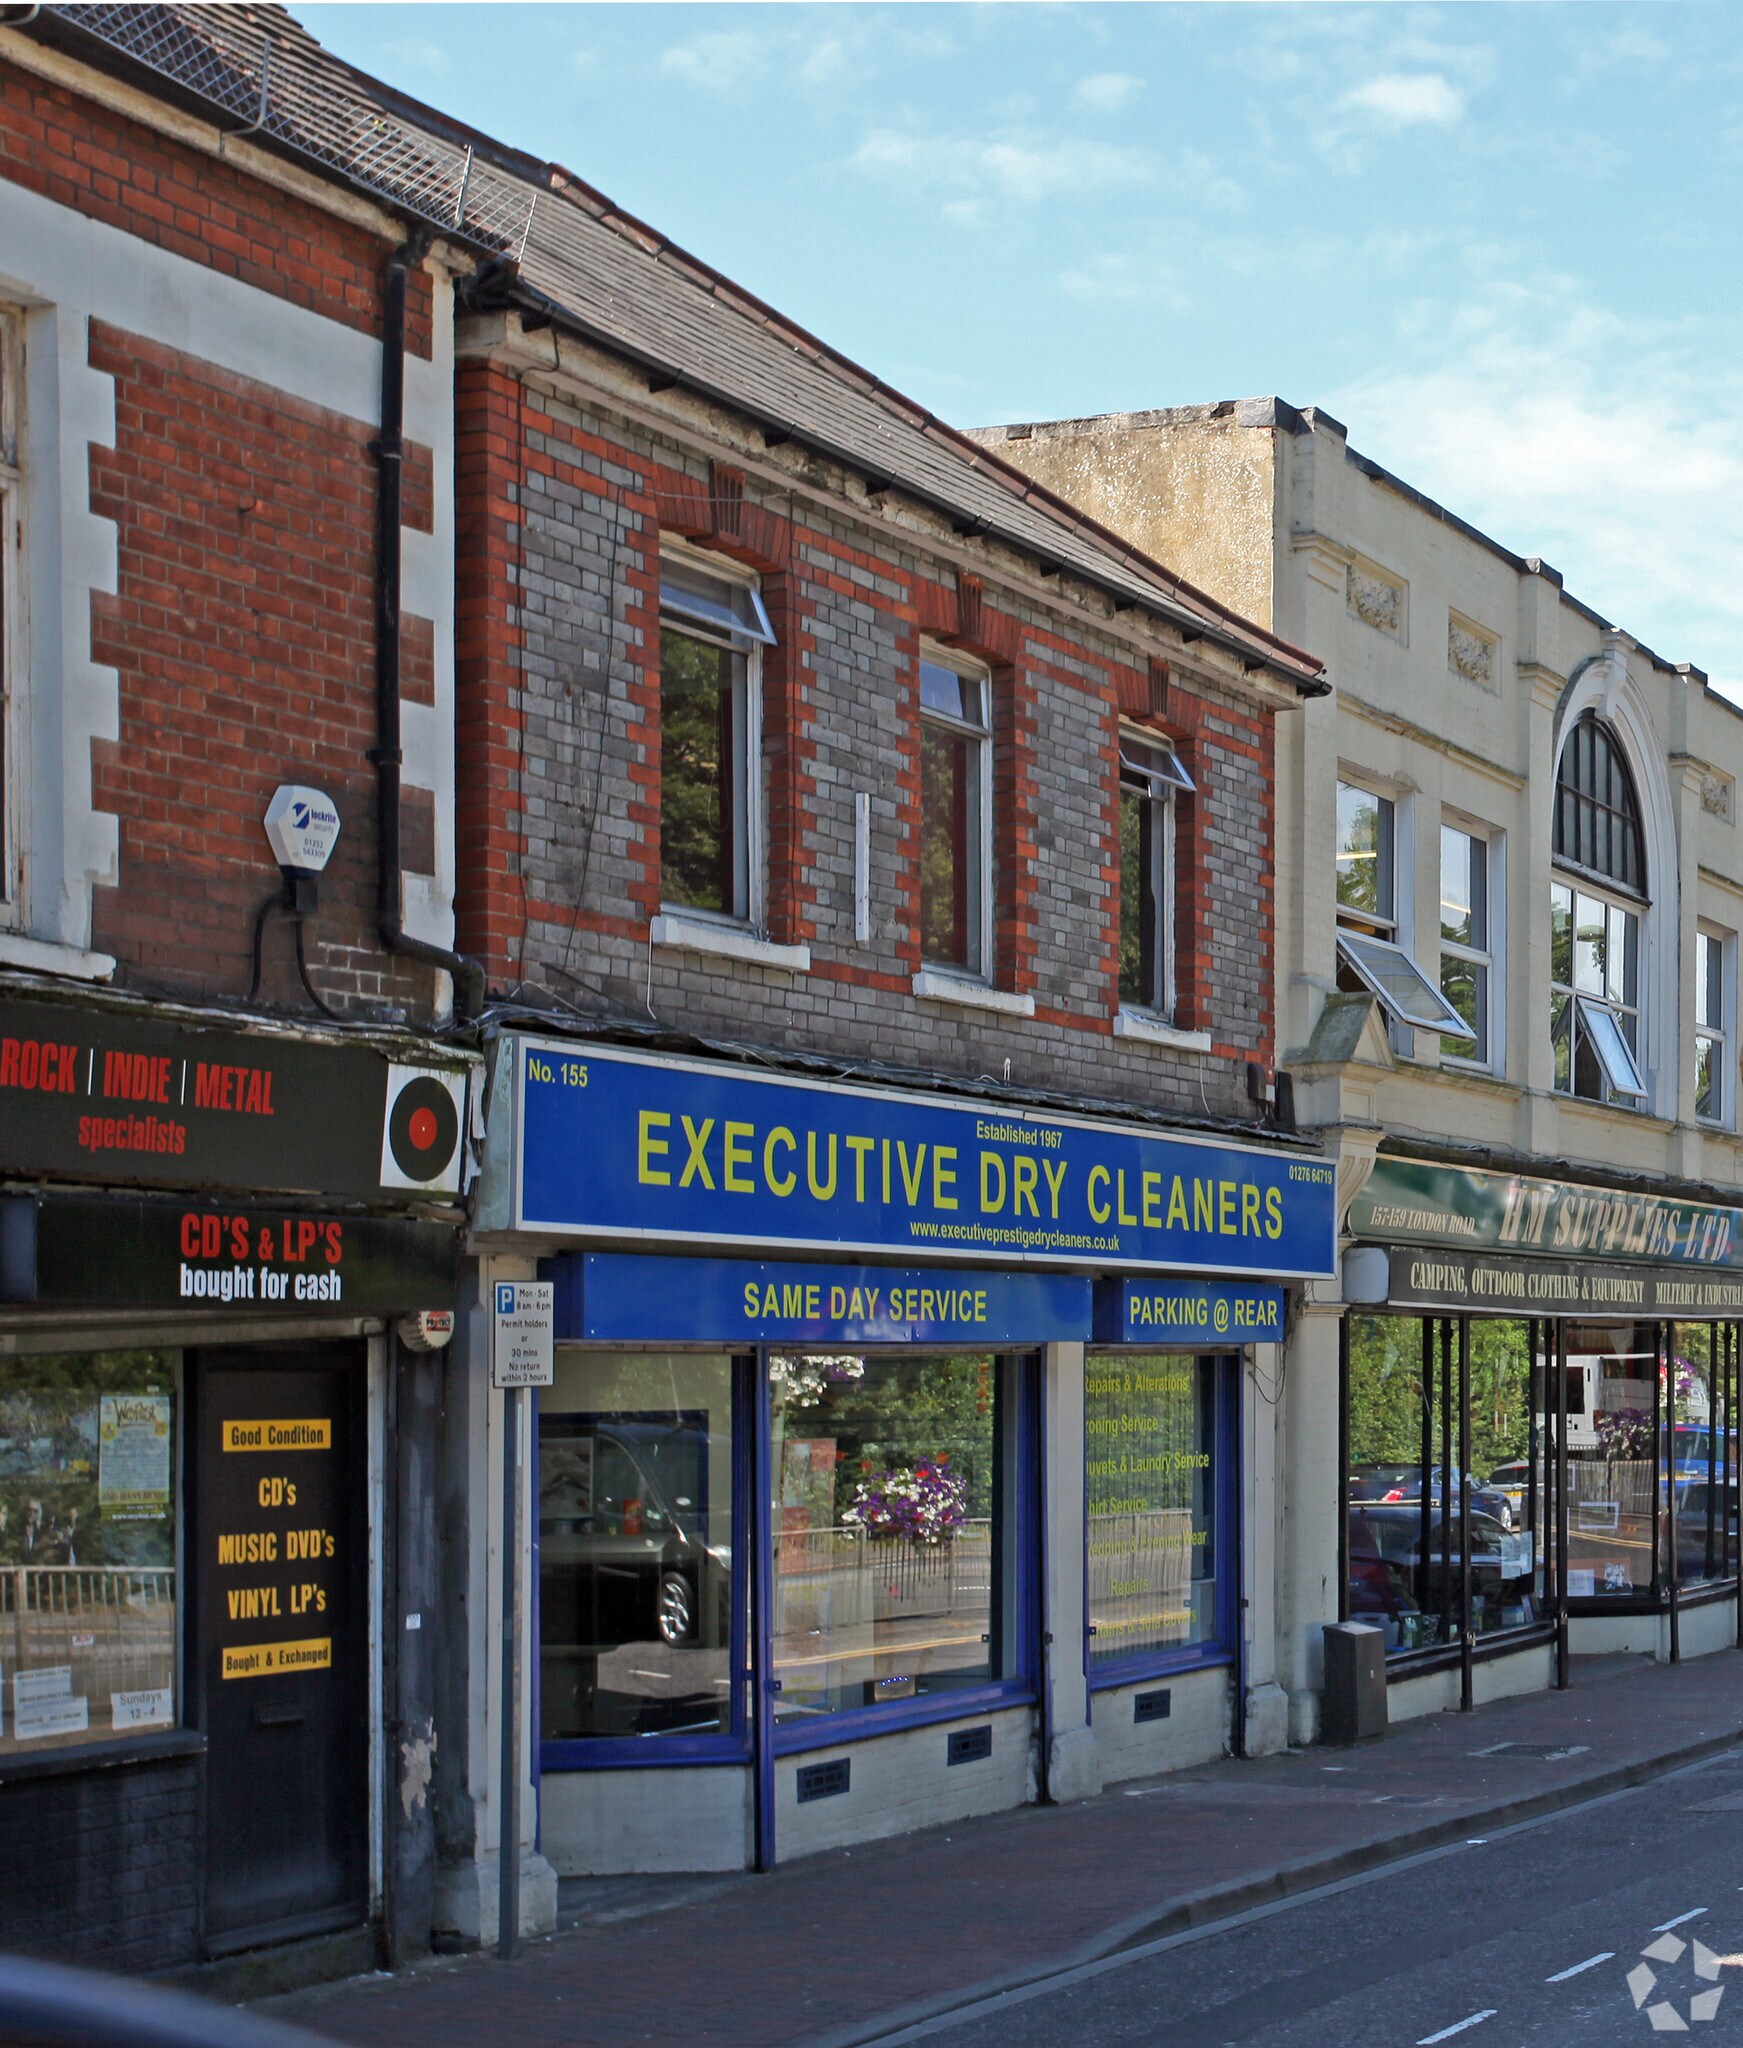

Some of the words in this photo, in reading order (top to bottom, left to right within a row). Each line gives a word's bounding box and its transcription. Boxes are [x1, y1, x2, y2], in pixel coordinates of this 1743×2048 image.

[0, 1038, 77, 1094] ROCK
[103, 1050, 172, 1104] INDIE
[195, 1063, 274, 1116] METAL
[528, 1057, 556, 1084] No.
[560, 1062, 589, 1089] 155
[79, 1114, 186, 1155] specialists
[976, 1119, 1038, 1147] Established
[1039, 1129, 1063, 1149] 1967
[637, 1109, 959, 1210] EXECUTIVE
[979, 1149, 1068, 1220] DRY
[1087, 1164, 1283, 1240] CLEANERS
[1288, 1165, 1311, 1183] 01276
[1311, 1167, 1333, 1186] 64719
[910, 1220, 1120, 1252] www.executiveprestigedrycleaners.co.uk
[1407, 1210, 1449, 1233] LONDON
[1448, 1214, 1476, 1236] ROAD
[1498, 1187, 1552, 1244] HM
[1553, 1194, 1682, 1257] SUPPLIES
[1683, 1212, 1731, 1262] LTD
[181, 1212, 250, 1260] CD'S
[258, 1228, 274, 1261] &
[282, 1219, 343, 1264] LP'S
[180, 1263, 254, 1303] bought
[260, 1266, 289, 1300] for
[294, 1268, 342, 1301] cash
[519, 1289, 534, 1298] Mon
[537, 1288, 549, 1298] Sat
[1410, 1261, 1468, 1298] CAMPING,
[1471, 1267, 1525, 1298] OUTDOOR
[1527, 1272, 1579, 1300] CLOTHING
[1581, 1277, 1590, 1300] &
[1591, 1276, 1645, 1304] EQUIPMENT
[1655, 1282, 1696, 1305] MILITARY
[1696, 1283, 1703, 1305] &
[501, 1288, 513, 1312] P
[743, 1282, 821, 1319] SAME
[829, 1286, 880, 1321] DAY
[889, 1288, 988, 1323] SERVICE
[501, 1319, 523, 1328] Permit
[524, 1319, 548, 1328] holders
[1129, 1295, 1209, 1326] PARKING
[1212, 1297, 1230, 1333] @
[1233, 1298, 1278, 1326] REAR
[512, 1348, 521, 1357] 30
[523, 1348, 538, 1357] mins
[501, 1374, 522, 1383] within
[523, 1374, 528, 1382] 2
[529, 1373, 548, 1382] hours
[509, 1362, 519, 1371] No
[520, 1362, 540, 1371] return
[1123, 1374, 1132, 1392] &
[1135, 1374, 1189, 1392] Alterations
[231, 1426, 262, 1447] Good
[268, 1424, 324, 1445] Condition
[1087, 1418, 1118, 1437] oning
[1121, 1414, 1158, 1433] Service
[1120, 1455, 1128, 1472] &
[1130, 1453, 1171, 1474] Laundry
[1174, 1451, 1210, 1469] Service
[258, 1476, 297, 1507] CD's
[1088, 1498, 1107, 1516] hirt
[1109, 1496, 1148, 1514] Service
[218, 1534, 277, 1565] MUSIC
[286, 1529, 335, 1560] DVD's
[1129, 1535, 1136, 1553] &
[1140, 1533, 1181, 1554] Evening
[1182, 1529, 1208, 1546] Wear
[1110, 1577, 1149, 1598] Repairs
[227, 1586, 281, 1620] VINYL
[290, 1583, 327, 1615] LP's
[226, 1653, 260, 1672] Bought
[265, 1650, 274, 1667] &
[279, 1644, 328, 1666] Exchanged
[120, 1691, 163, 1706] Sundays
[130, 1709, 141, 1720] 12
[149, 1706, 156, 1716] 4
